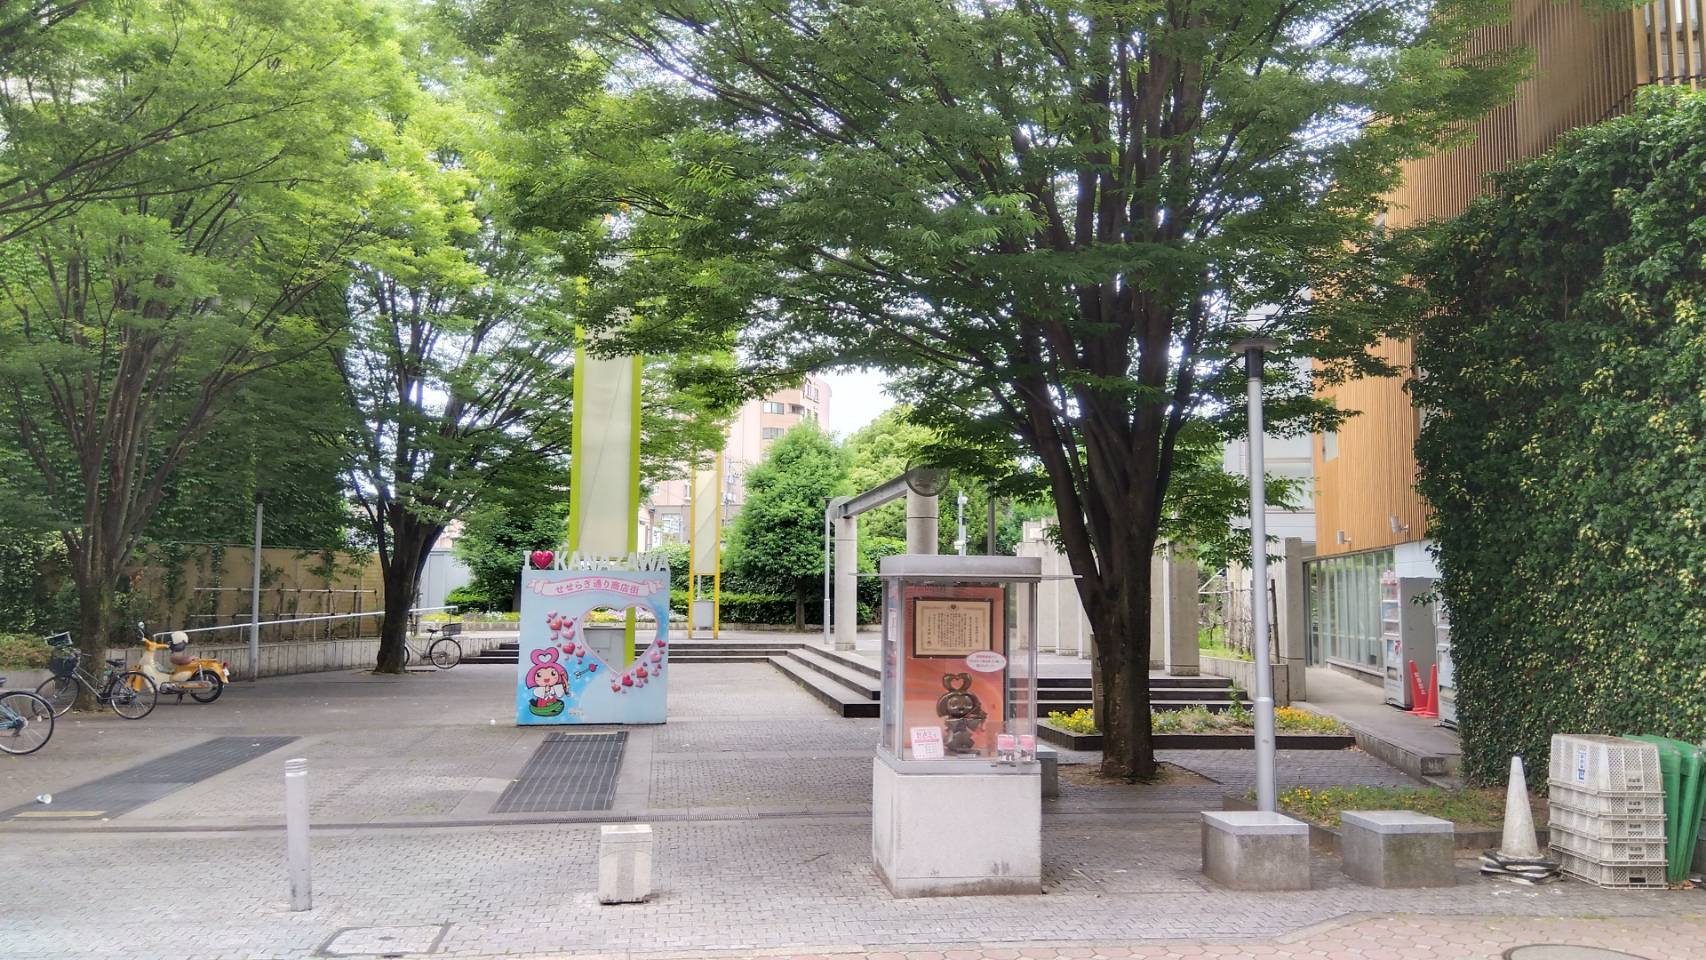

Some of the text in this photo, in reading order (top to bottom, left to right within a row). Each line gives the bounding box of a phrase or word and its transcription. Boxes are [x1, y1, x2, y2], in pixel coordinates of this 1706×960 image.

[523, 550, 670, 572] I KANAZAWA
[555, 579, 640, 594] せせらぎ通り商店街
